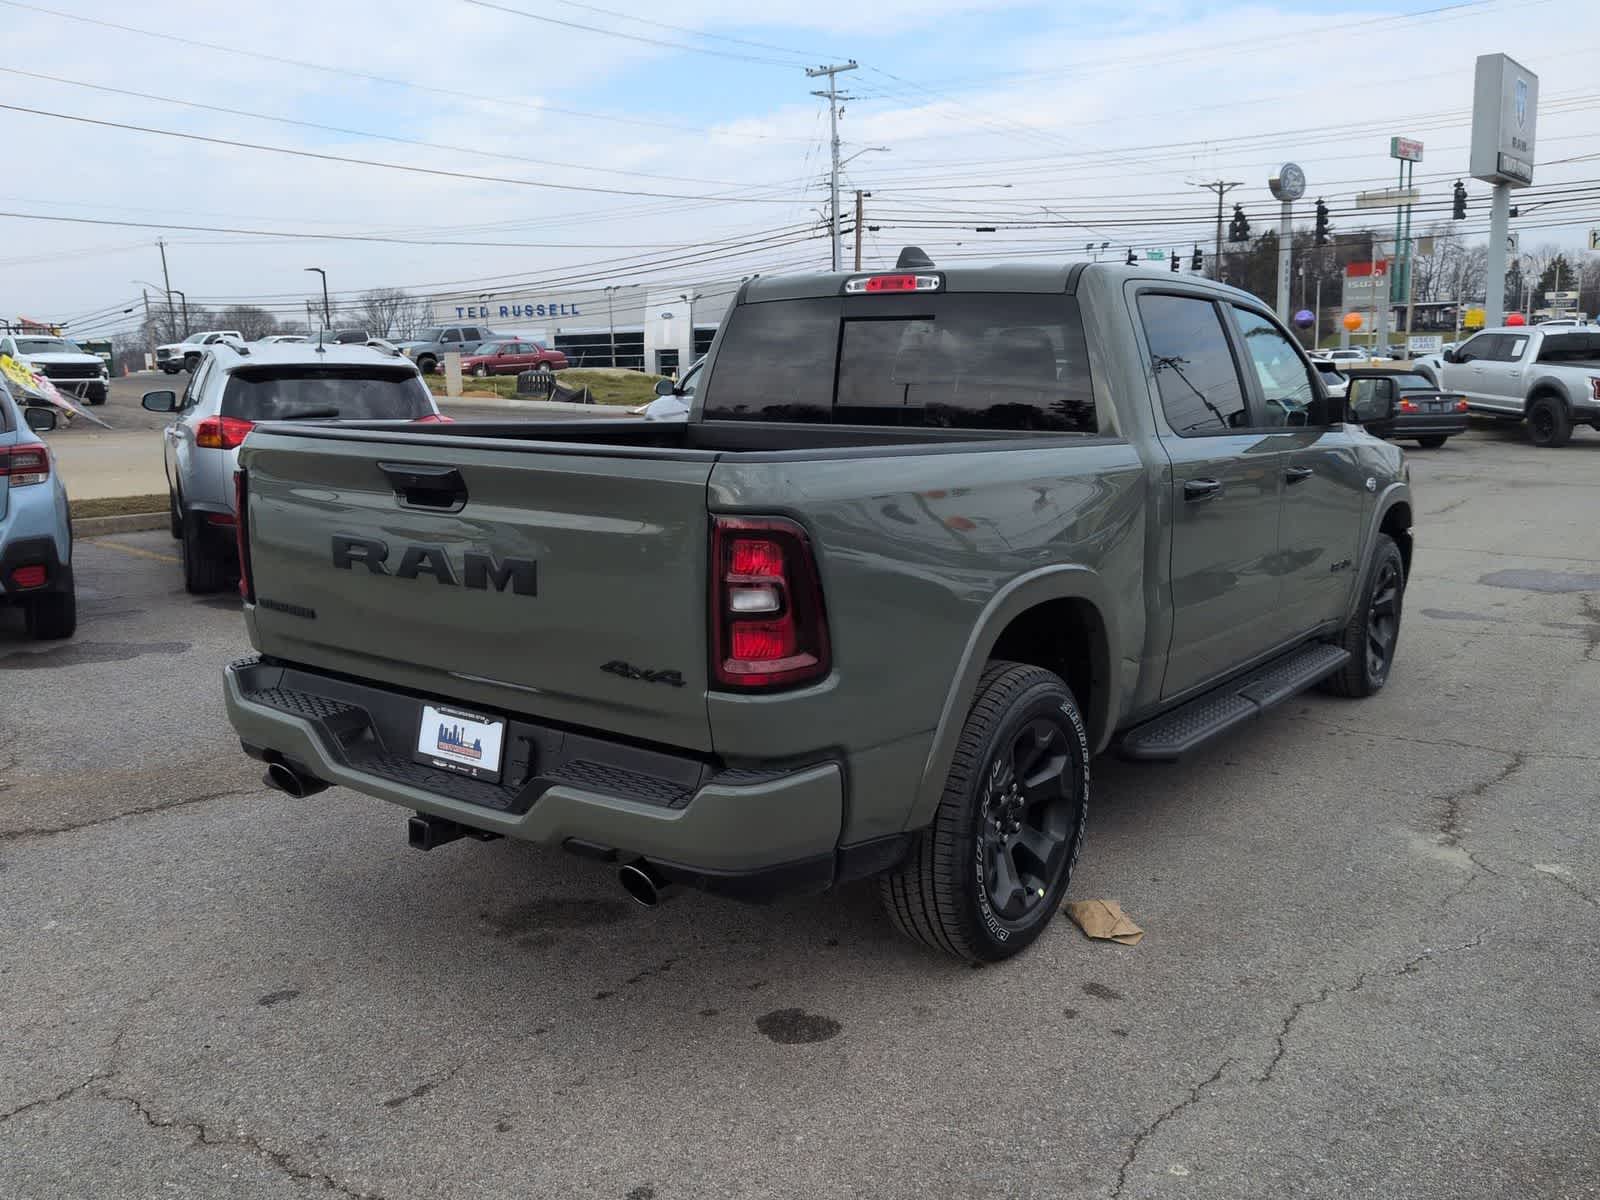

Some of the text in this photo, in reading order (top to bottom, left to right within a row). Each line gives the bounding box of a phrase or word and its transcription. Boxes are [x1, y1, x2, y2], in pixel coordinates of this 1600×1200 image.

[455, 303, 580, 319] TED RUSSELL
[332, 532, 539, 596] RAM
